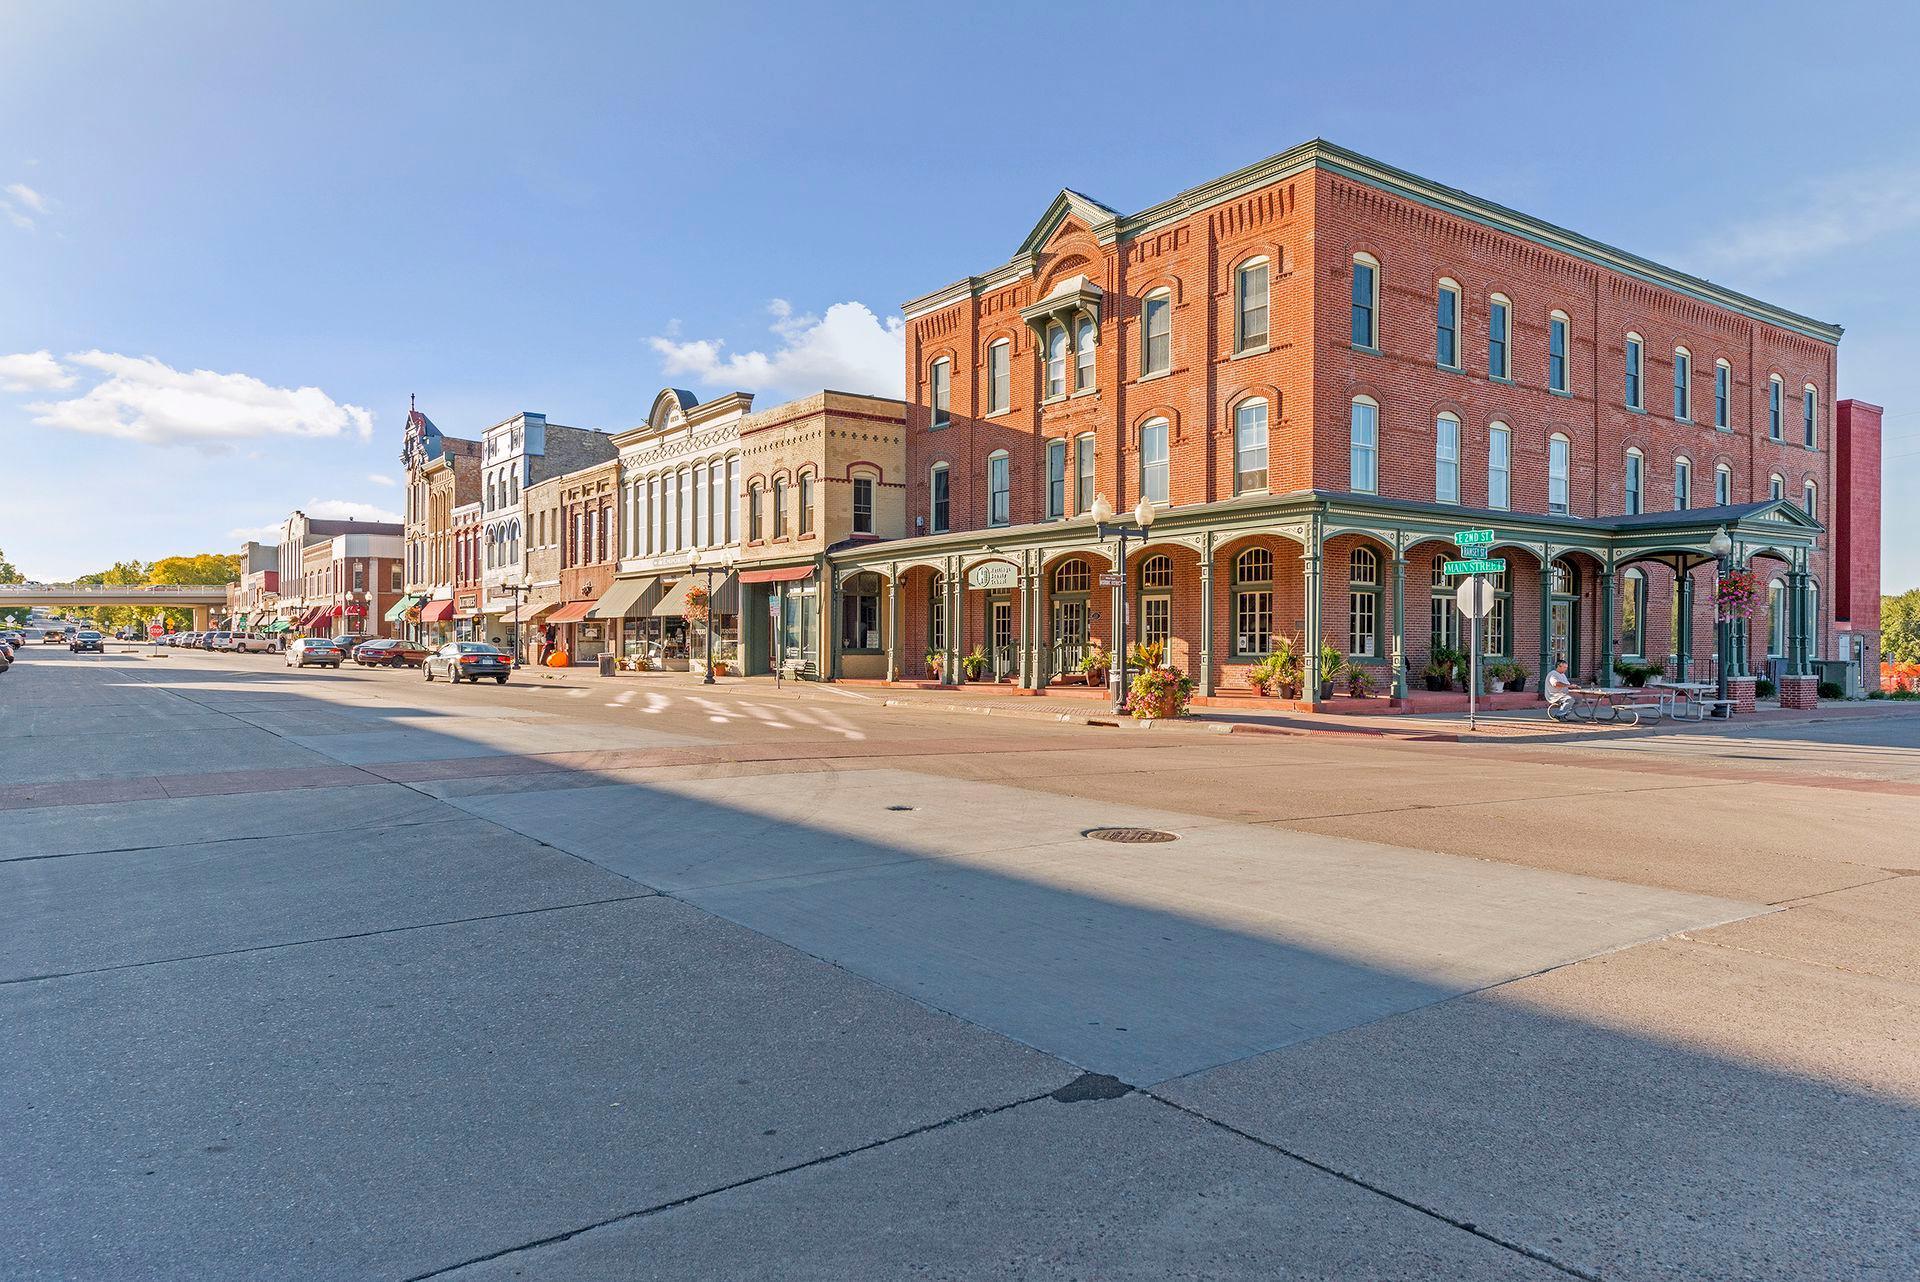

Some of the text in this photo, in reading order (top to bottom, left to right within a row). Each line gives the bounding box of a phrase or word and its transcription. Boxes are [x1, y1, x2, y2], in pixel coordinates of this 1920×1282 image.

[1458, 534, 1462, 543] E
[1464, 533, 1479, 543] 2ND
[1447, 559, 1503, 573] MAIN STREET
